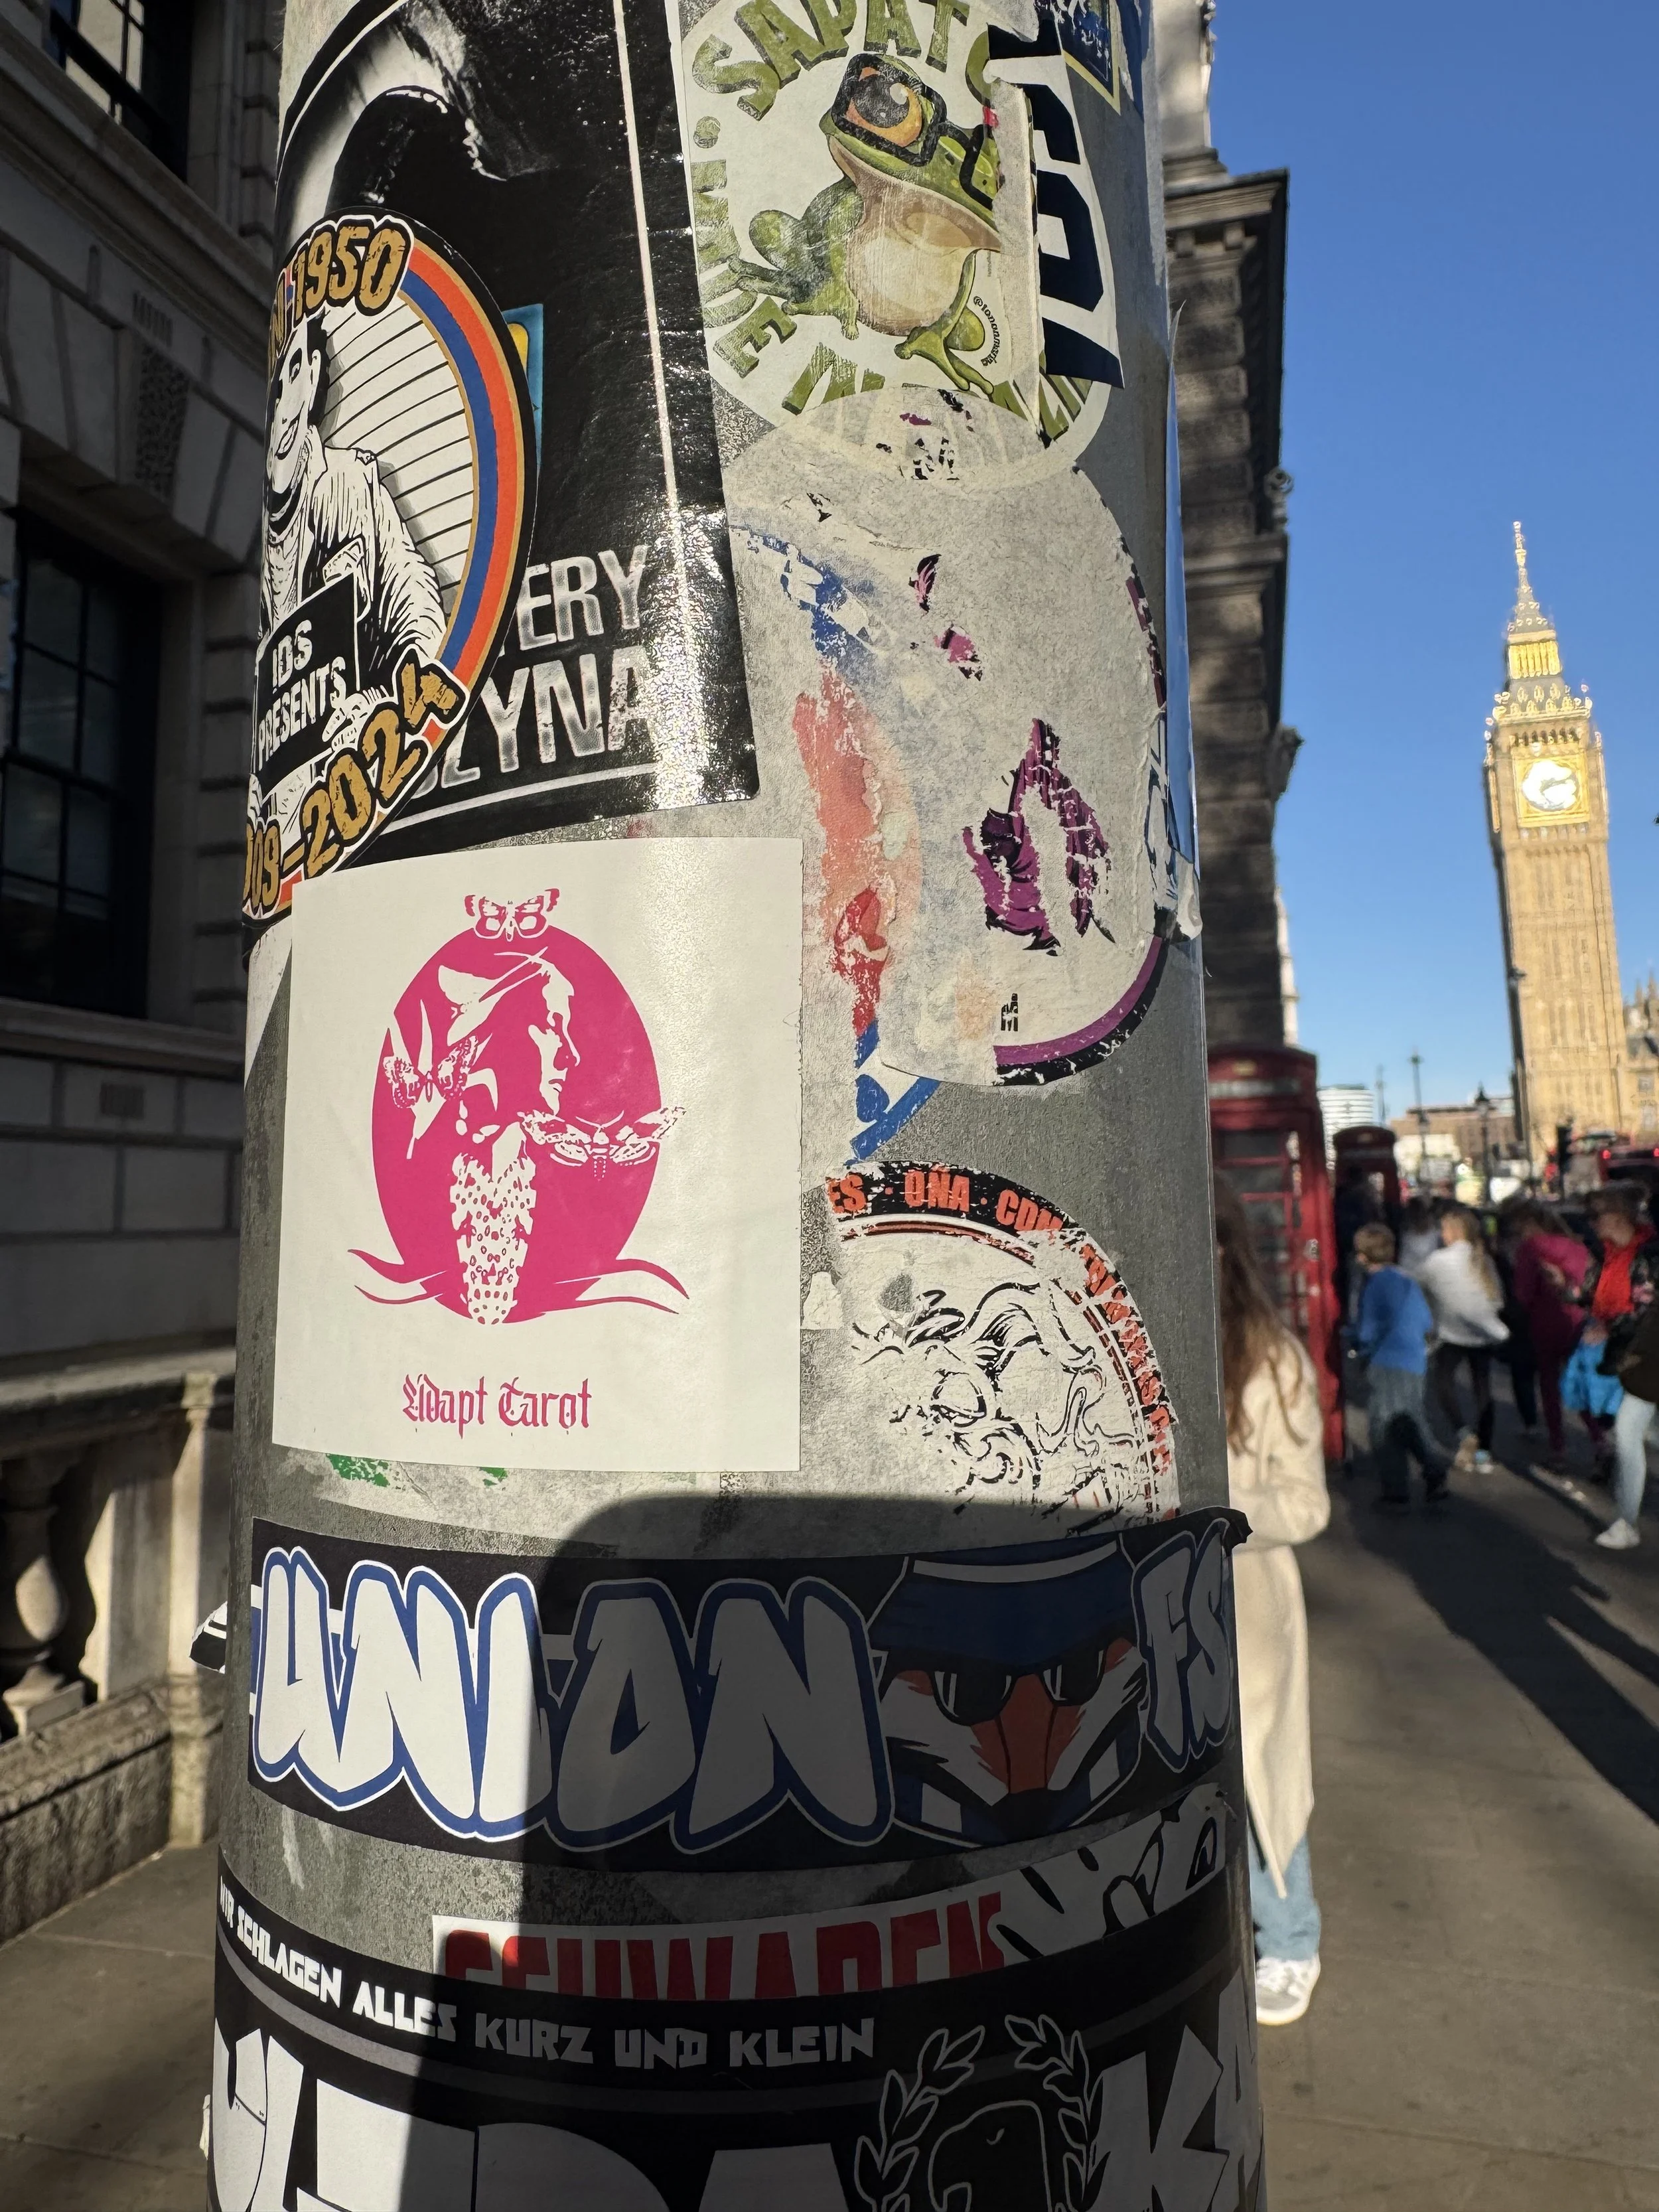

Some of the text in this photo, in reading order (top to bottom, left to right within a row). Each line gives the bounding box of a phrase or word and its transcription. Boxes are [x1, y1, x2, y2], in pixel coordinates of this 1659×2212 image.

[293, 224, 407, 321] 1950
[258, 656, 347, 772] PRESENTS
[498, 1376, 593, 1429] Tarot
[253, 1546, 895, 1854] UNION
[237, 1905, 343, 2008] SCHLAGEN
[352, 1981, 458, 2043] ALLES
[474, 2012, 594, 2066] KURZ
[614, 2028, 708, 2070] UND
[729, 2017, 875, 2067] KLEIN
